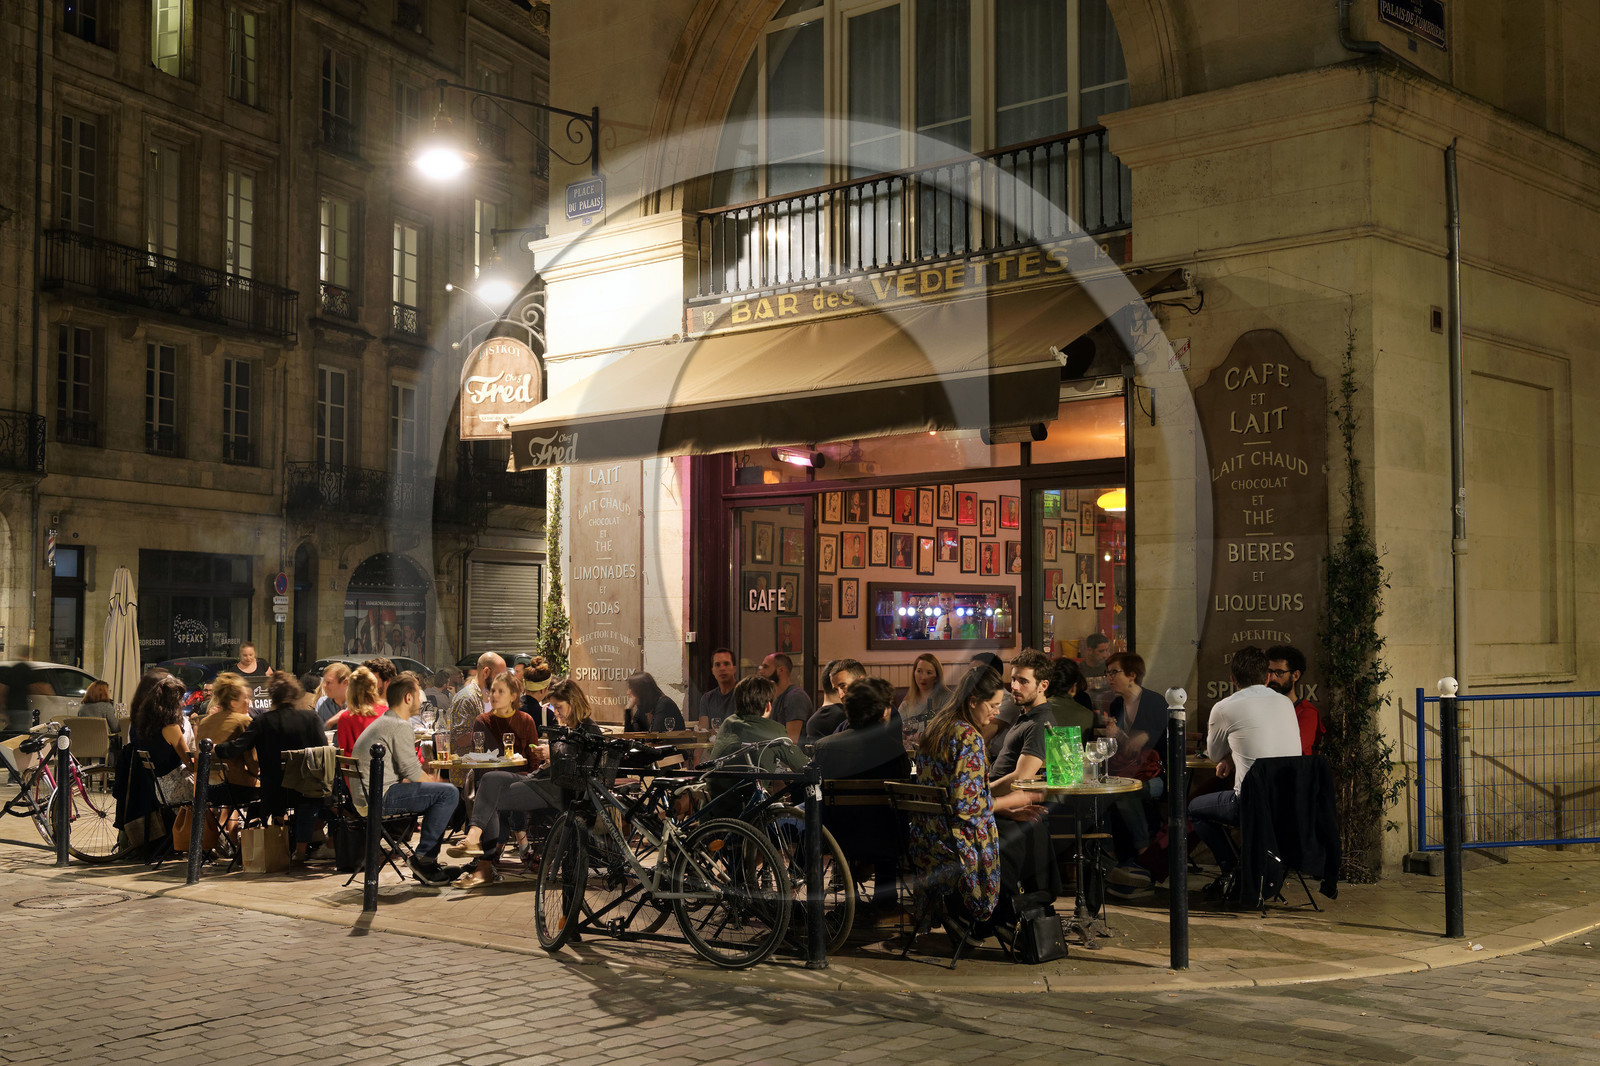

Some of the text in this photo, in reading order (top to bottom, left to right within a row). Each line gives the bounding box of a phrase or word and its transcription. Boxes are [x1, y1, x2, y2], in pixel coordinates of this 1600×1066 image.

[573, 185, 595, 198] PLACE
[568, 197, 601, 213] DU PALAIS
[731, 293, 799, 324] BAR
[812, 289, 855, 311] des
[871, 248, 1070, 300] VEDETTES
[1093, 243, 1110, 260] 19
[1224, 362, 1290, 391] CAFE
[464, 370, 534, 404] Fred
[1250, 392, 1266, 405] ET
[1229, 406, 1289, 435] LAIT
[528, 430, 580, 467] Fred
[588, 465, 622, 485] LAIT
[1211, 451, 1309, 482] LAIT CHAUD
[1231, 476, 1288, 490] CHOCOLAT
[578, 497, 631, 520] LAIT CHAUD
[1252, 495, 1265, 506] ET
[588, 516, 620, 527] CHOCOLAT
[1242, 508, 1275, 525] THE
[599, 529, 608, 538] ET
[594, 540, 613, 552] THE
[1228, 541, 1295, 563] BIERES
[573, 563, 636, 580] LIMONADES
[1252, 571, 1265, 582] ET
[599, 586, 607, 594] ET
[587, 601, 620, 615] SODAS
[749, 586, 787, 613] CAFÉ
[1215, 593, 1304, 612] LIQUEURS
[177, 633, 204, 643] SPEAKS
[575, 630, 609, 647] SELECTION
[1231, 629, 1292, 644] APERITIFS
